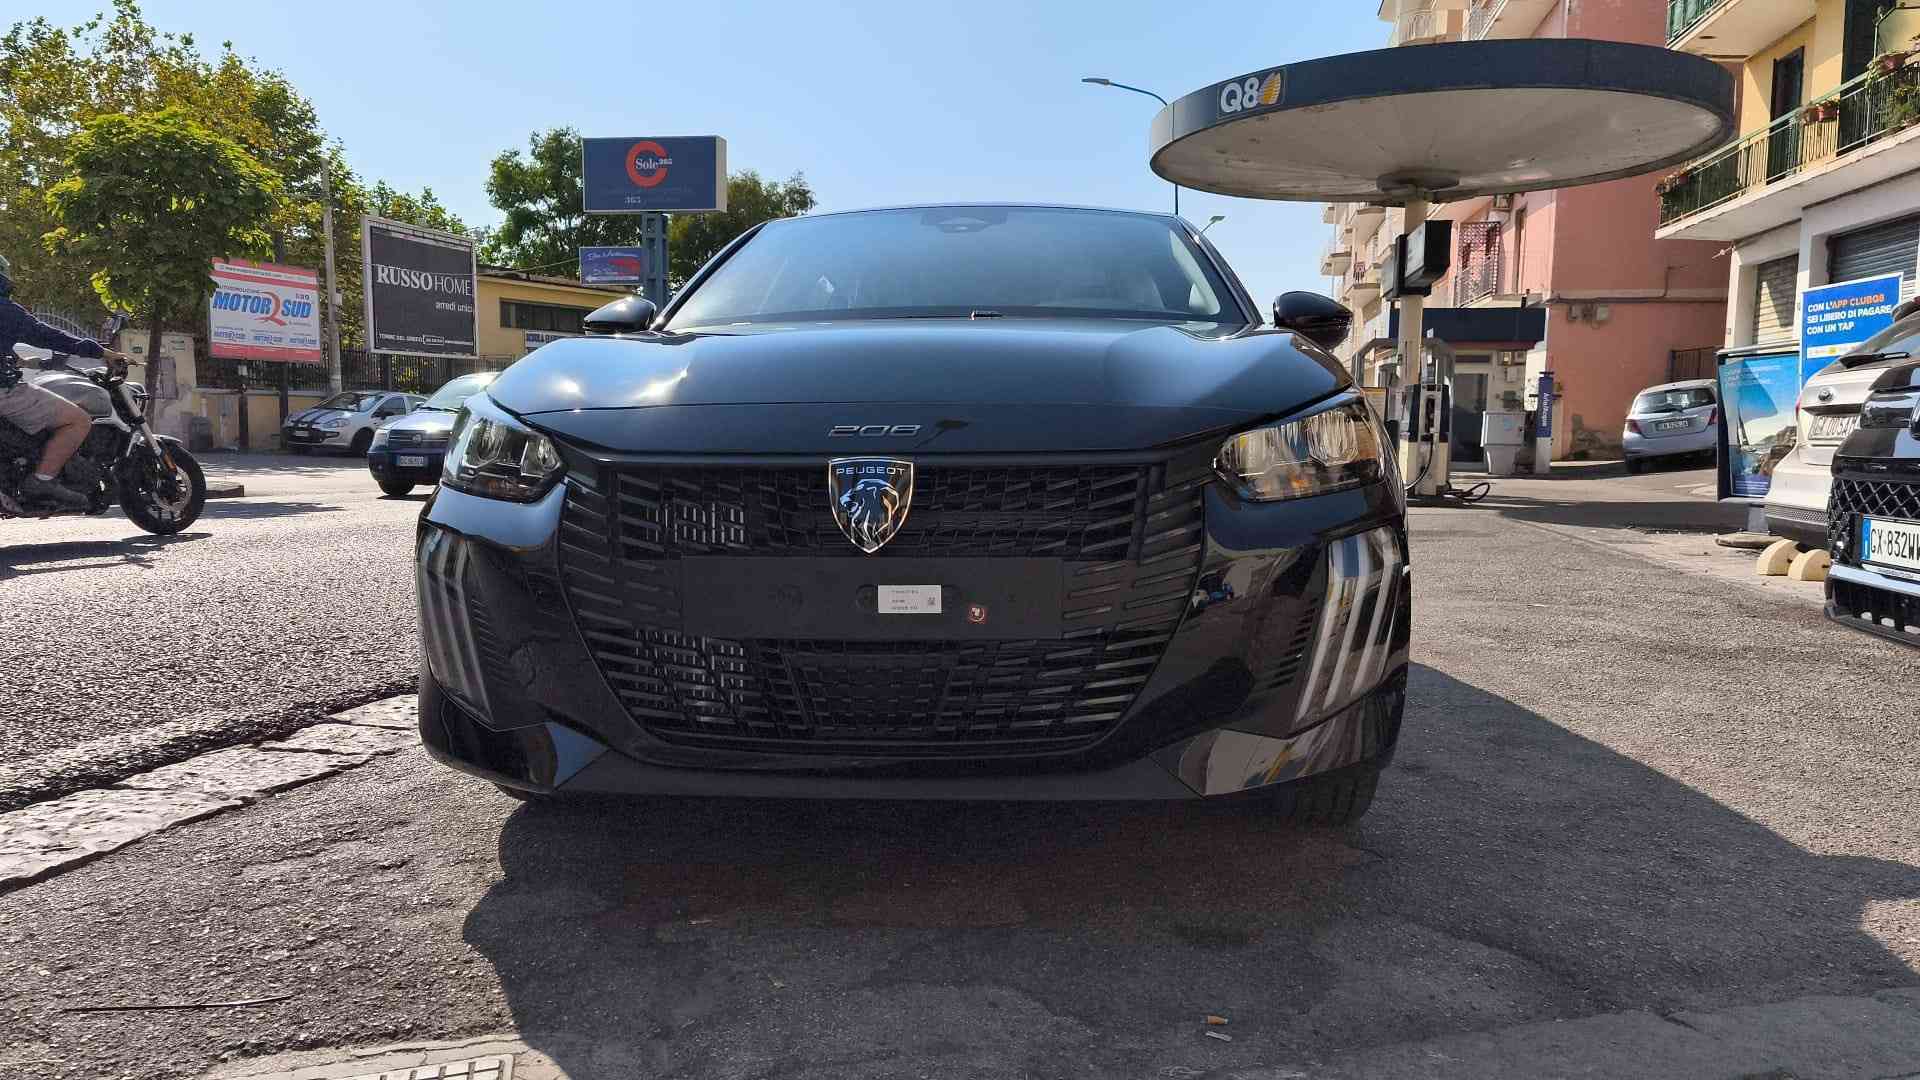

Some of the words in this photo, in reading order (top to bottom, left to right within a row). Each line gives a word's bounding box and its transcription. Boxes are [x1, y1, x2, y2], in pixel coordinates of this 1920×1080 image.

[1221, 77, 1259, 112] Q8
[213, 291, 272, 315] MOTOR
[281, 299, 312, 319] SUD
[1807, 303, 1824, 313] CON
[1825, 299, 1848, 311] L'APP
[1807, 314, 1819, 324] SEI
[1820, 310, 1847, 321] LIBERO
[1847, 308, 1857, 319] DI
[1857, 304, 1892, 317] PAGARE
[1806, 326, 1824, 336] CON
[1824, 323, 1837, 333] UN
[1837, 321, 1855, 331] TAP
[827, 424, 921, 437] 208
[836, 466, 905, 475] PEUGEOT
